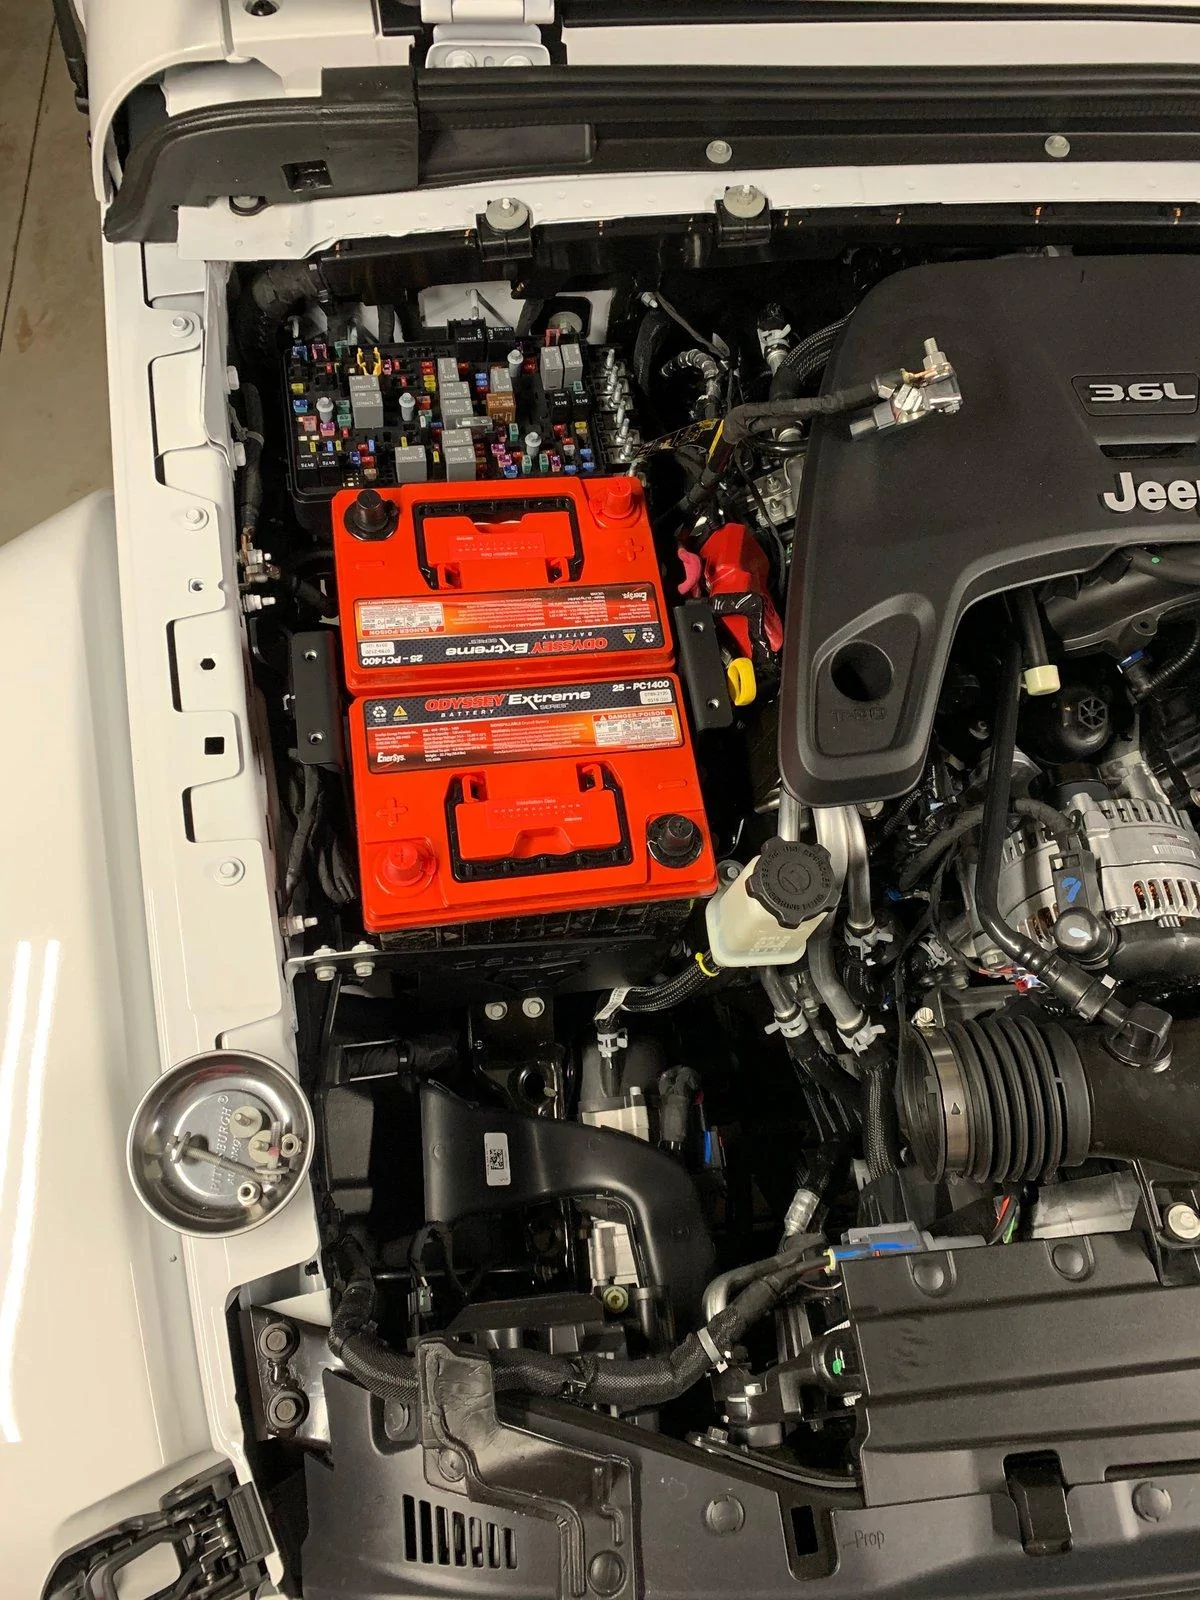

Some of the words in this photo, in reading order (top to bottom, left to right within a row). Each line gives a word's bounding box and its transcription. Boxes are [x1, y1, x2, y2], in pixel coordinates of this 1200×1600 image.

[1089, 382, 1196, 401] 3.6L
[1103, 471, 1200, 512] Jee
[542, 631, 593, 639] BATTERY
[445, 637, 529, 656] Extreme
[531, 637, 608, 654] ODYSSEY
[362, 656, 402, 666] PC1400
[632, 680, 670, 690] PC1400
[425, 693, 506, 711] ODYSSEY
[508, 690, 591, 710] Extreme
[440, 709, 494, 718] BATTERY
